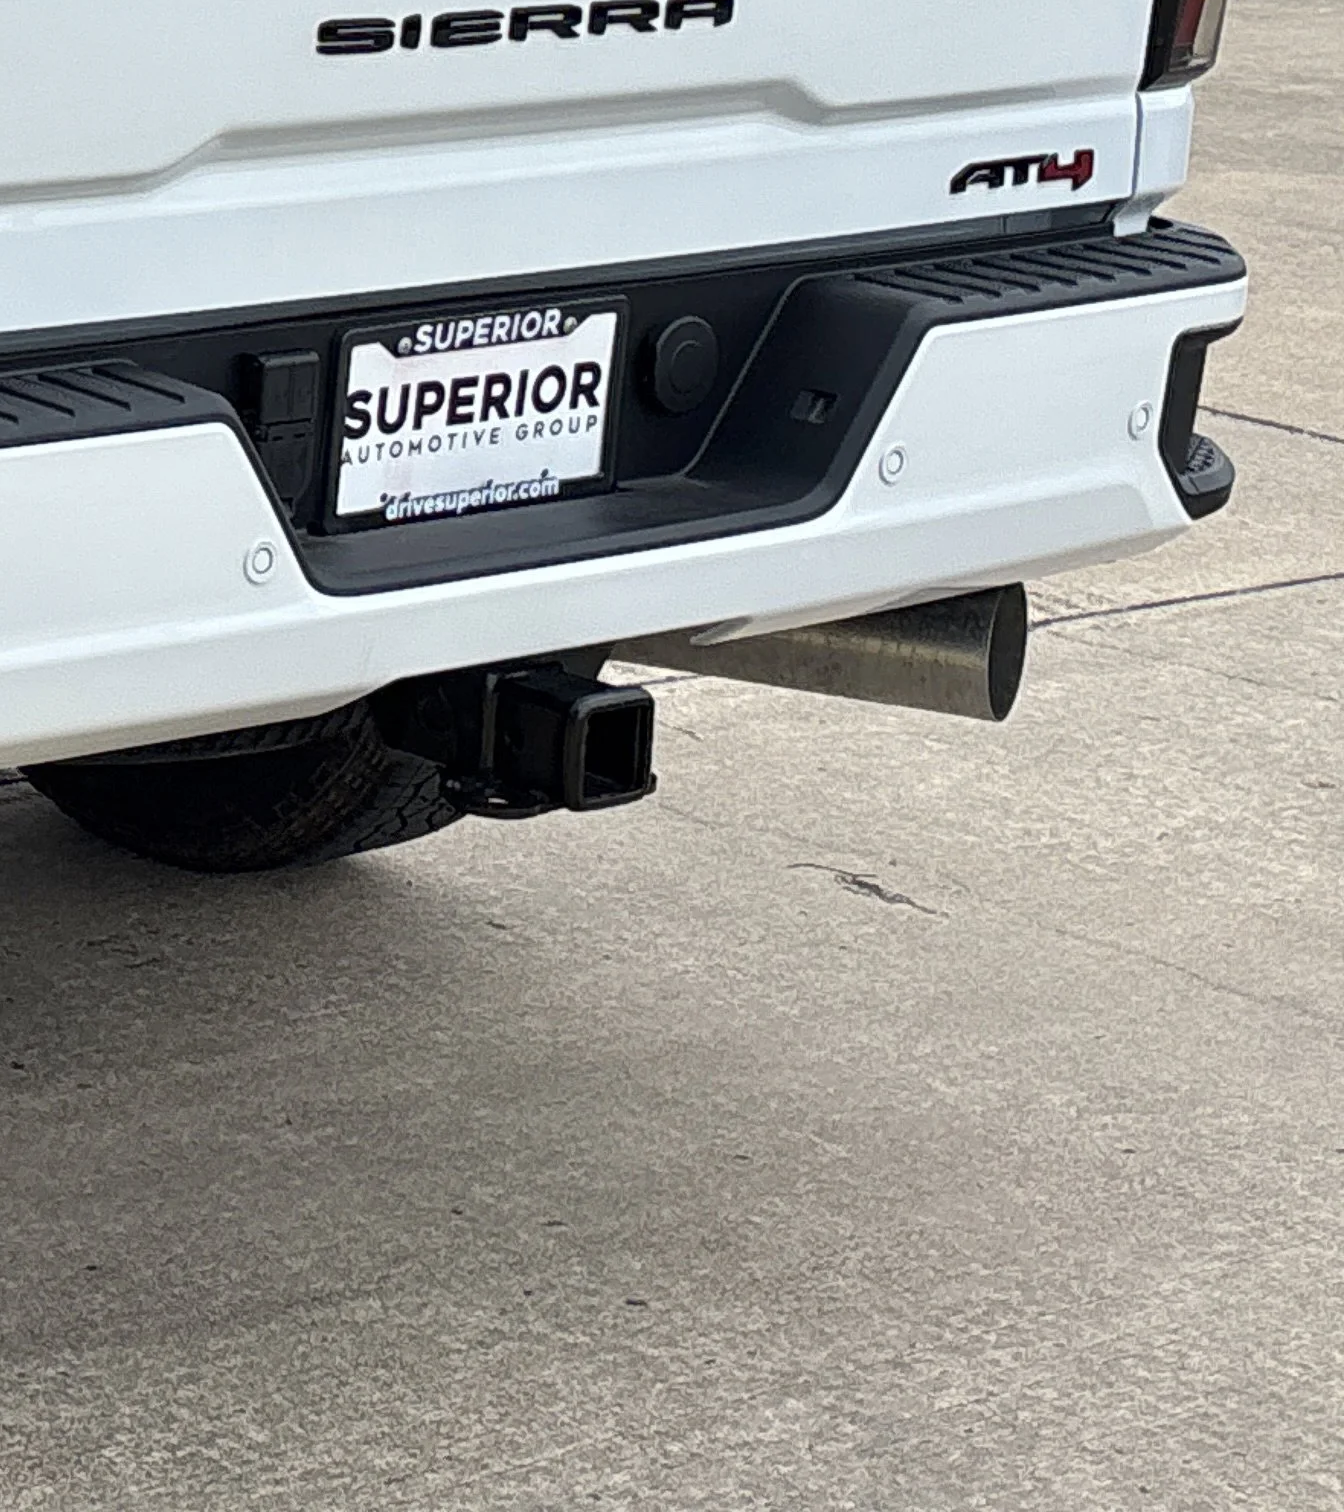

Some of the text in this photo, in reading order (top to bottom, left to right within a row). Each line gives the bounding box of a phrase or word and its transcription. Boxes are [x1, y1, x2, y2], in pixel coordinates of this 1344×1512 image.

[949, 148, 1094, 195] AT4
[413, 308, 563, 353] SUPERIOR
[343, 361, 603, 440] SUPERIOR
[340, 414, 599, 467] AUTOMOTIVE GROUP
[384, 477, 560, 522] drivesuperior.com
